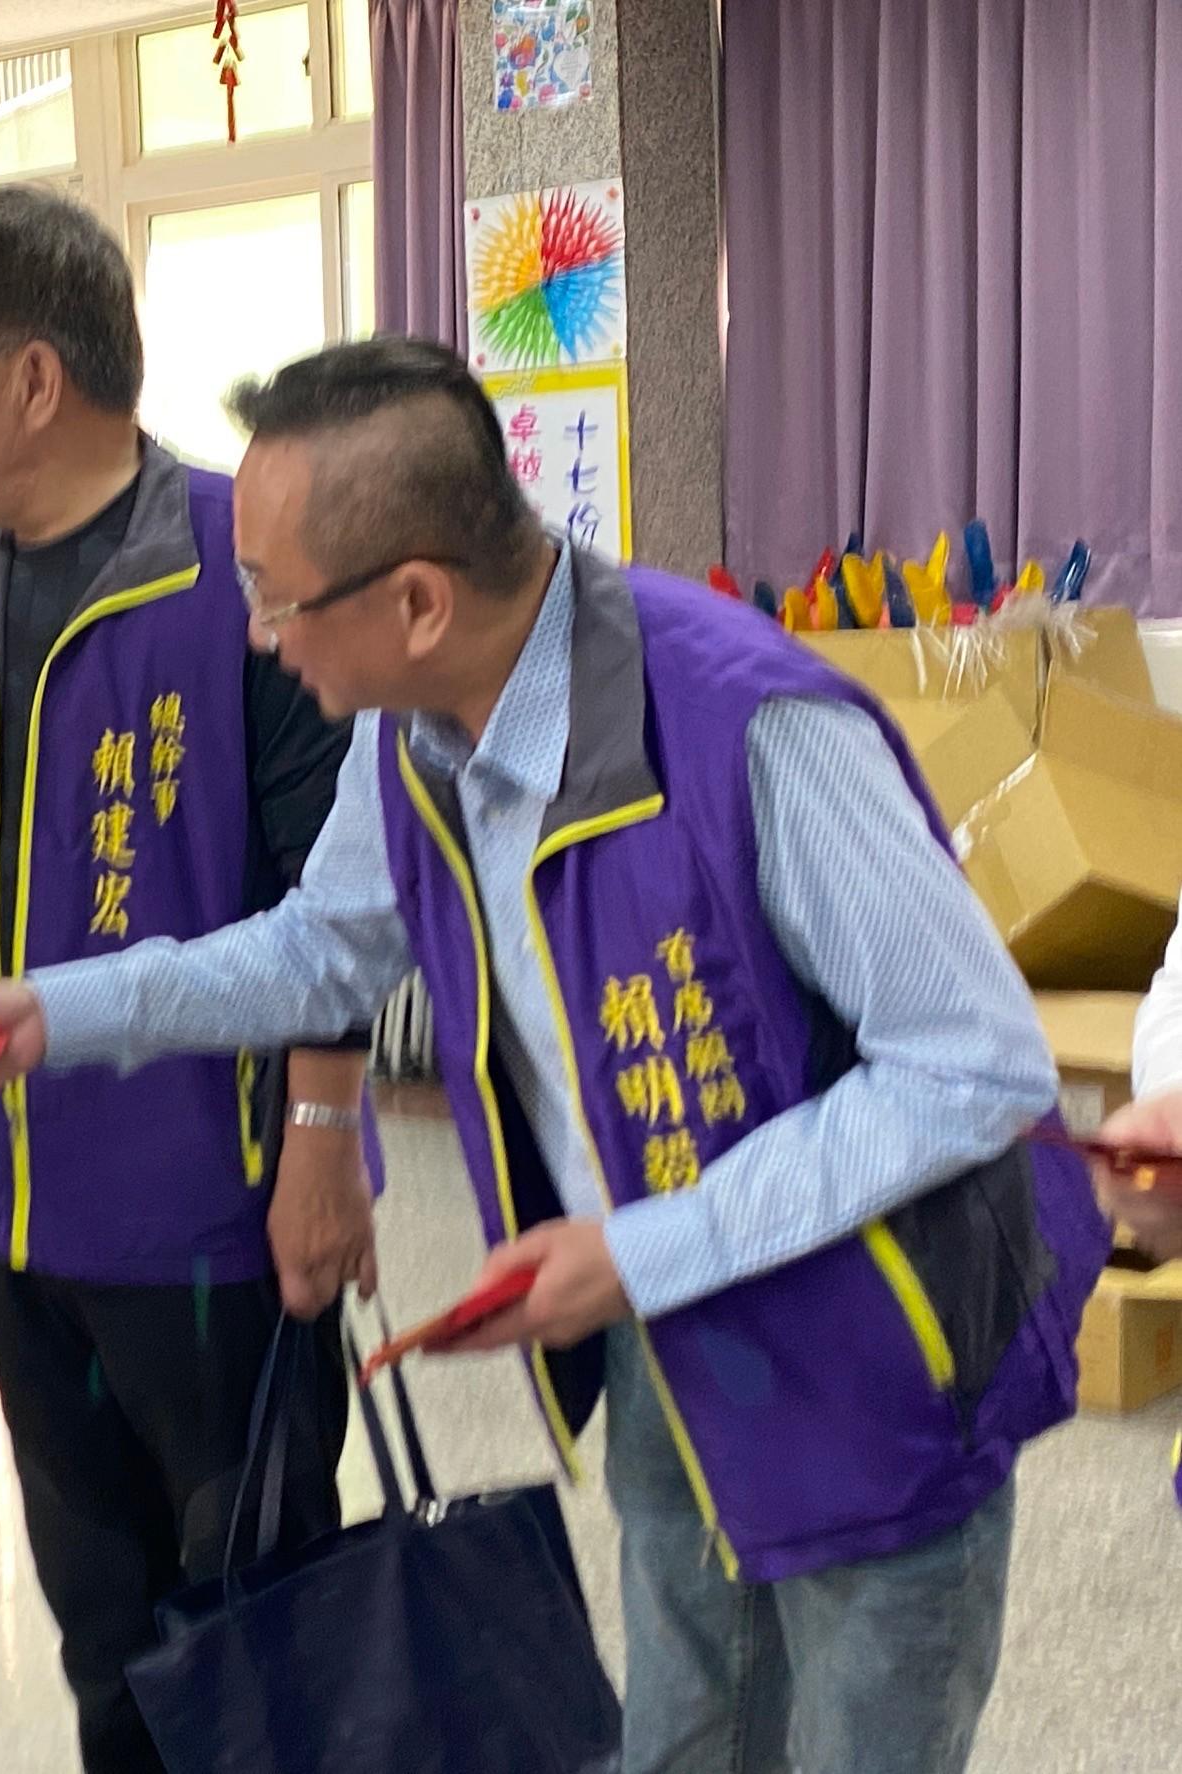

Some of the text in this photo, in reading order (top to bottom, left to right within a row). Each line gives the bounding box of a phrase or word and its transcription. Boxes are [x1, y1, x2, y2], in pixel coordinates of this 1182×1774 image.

[508, 403, 544, 520] 卓越
[89, 727, 137, 940] 賴建宏
[149, 691, 187, 827] 總幹事
[654, 926, 747, 1129] 首席顧問
